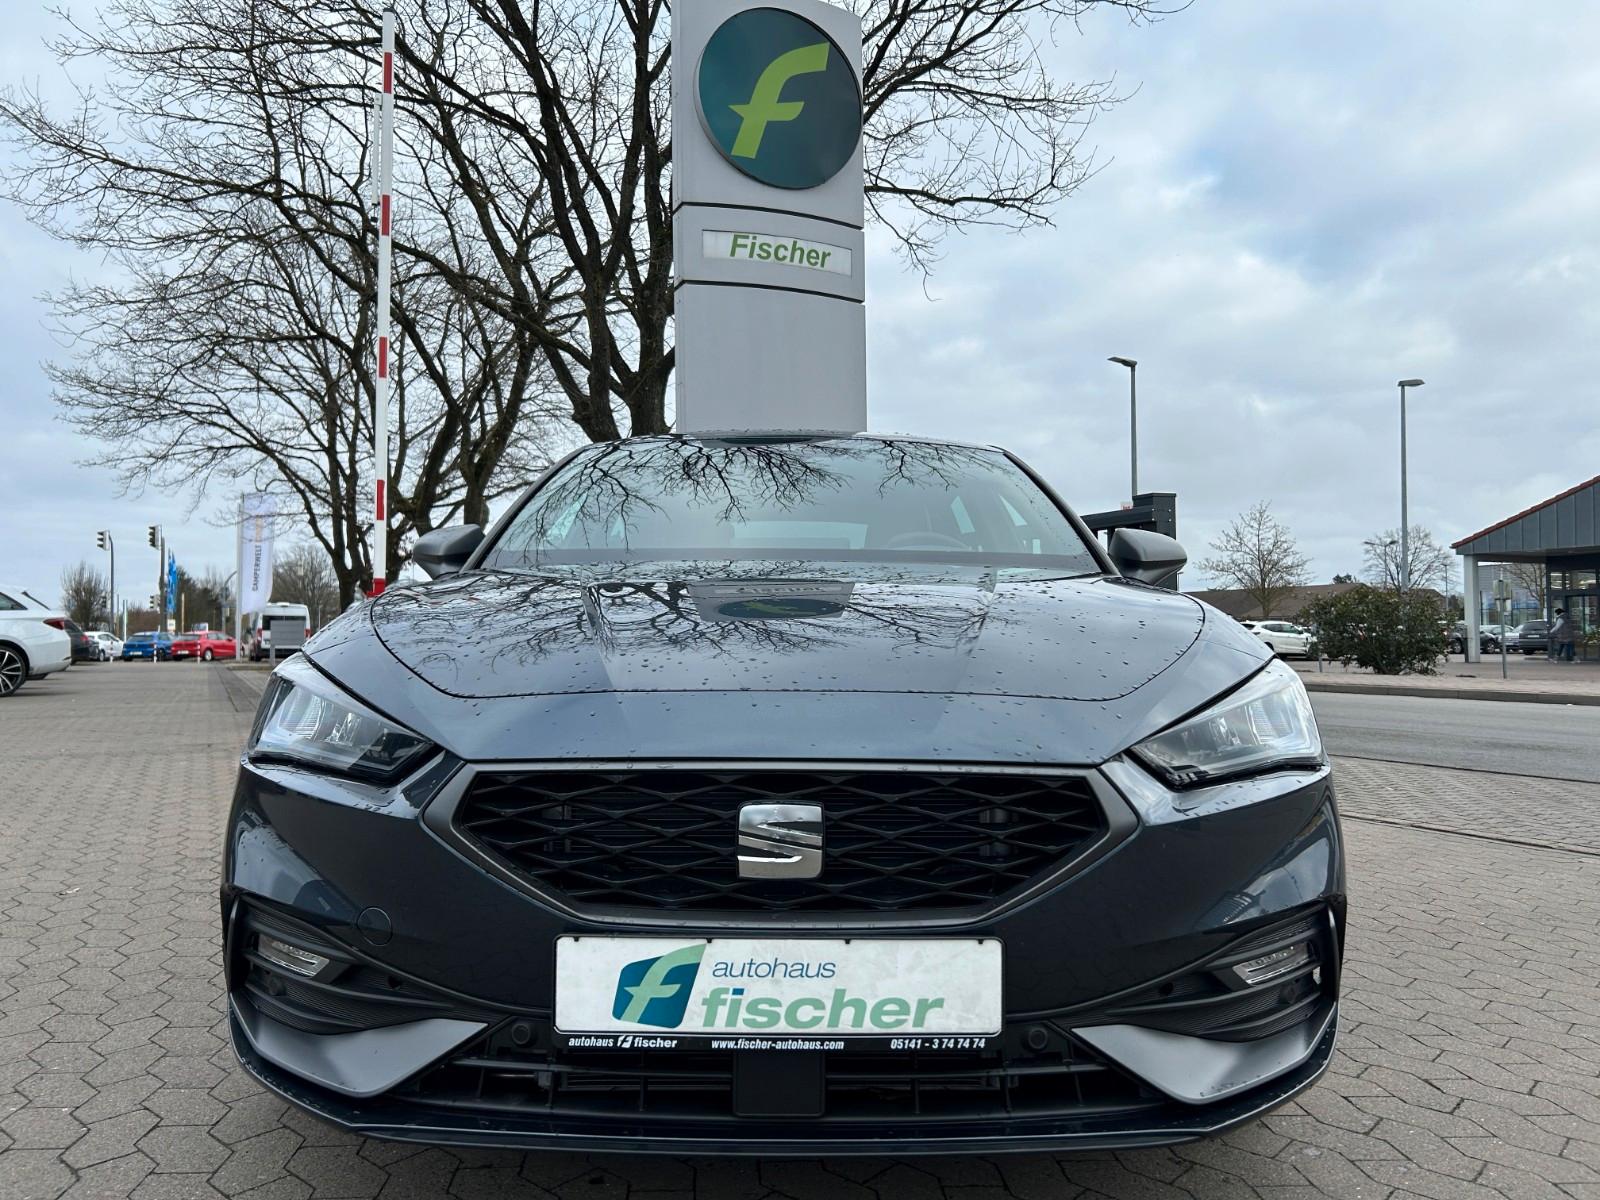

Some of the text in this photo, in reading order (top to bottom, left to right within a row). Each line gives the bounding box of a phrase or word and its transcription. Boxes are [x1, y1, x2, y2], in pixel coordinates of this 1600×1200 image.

[729, 233, 832, 268] Fischer
[711, 957, 836, 978] autohaus
[702, 987, 944, 1029] fischer
[568, 1036, 614, 1047] autohaus
[634, 1037, 678, 1048] fischer
[711, 1038, 845, 1050] www.fischer-autohaus.com
[890, 1038, 922, 1050] 05141
